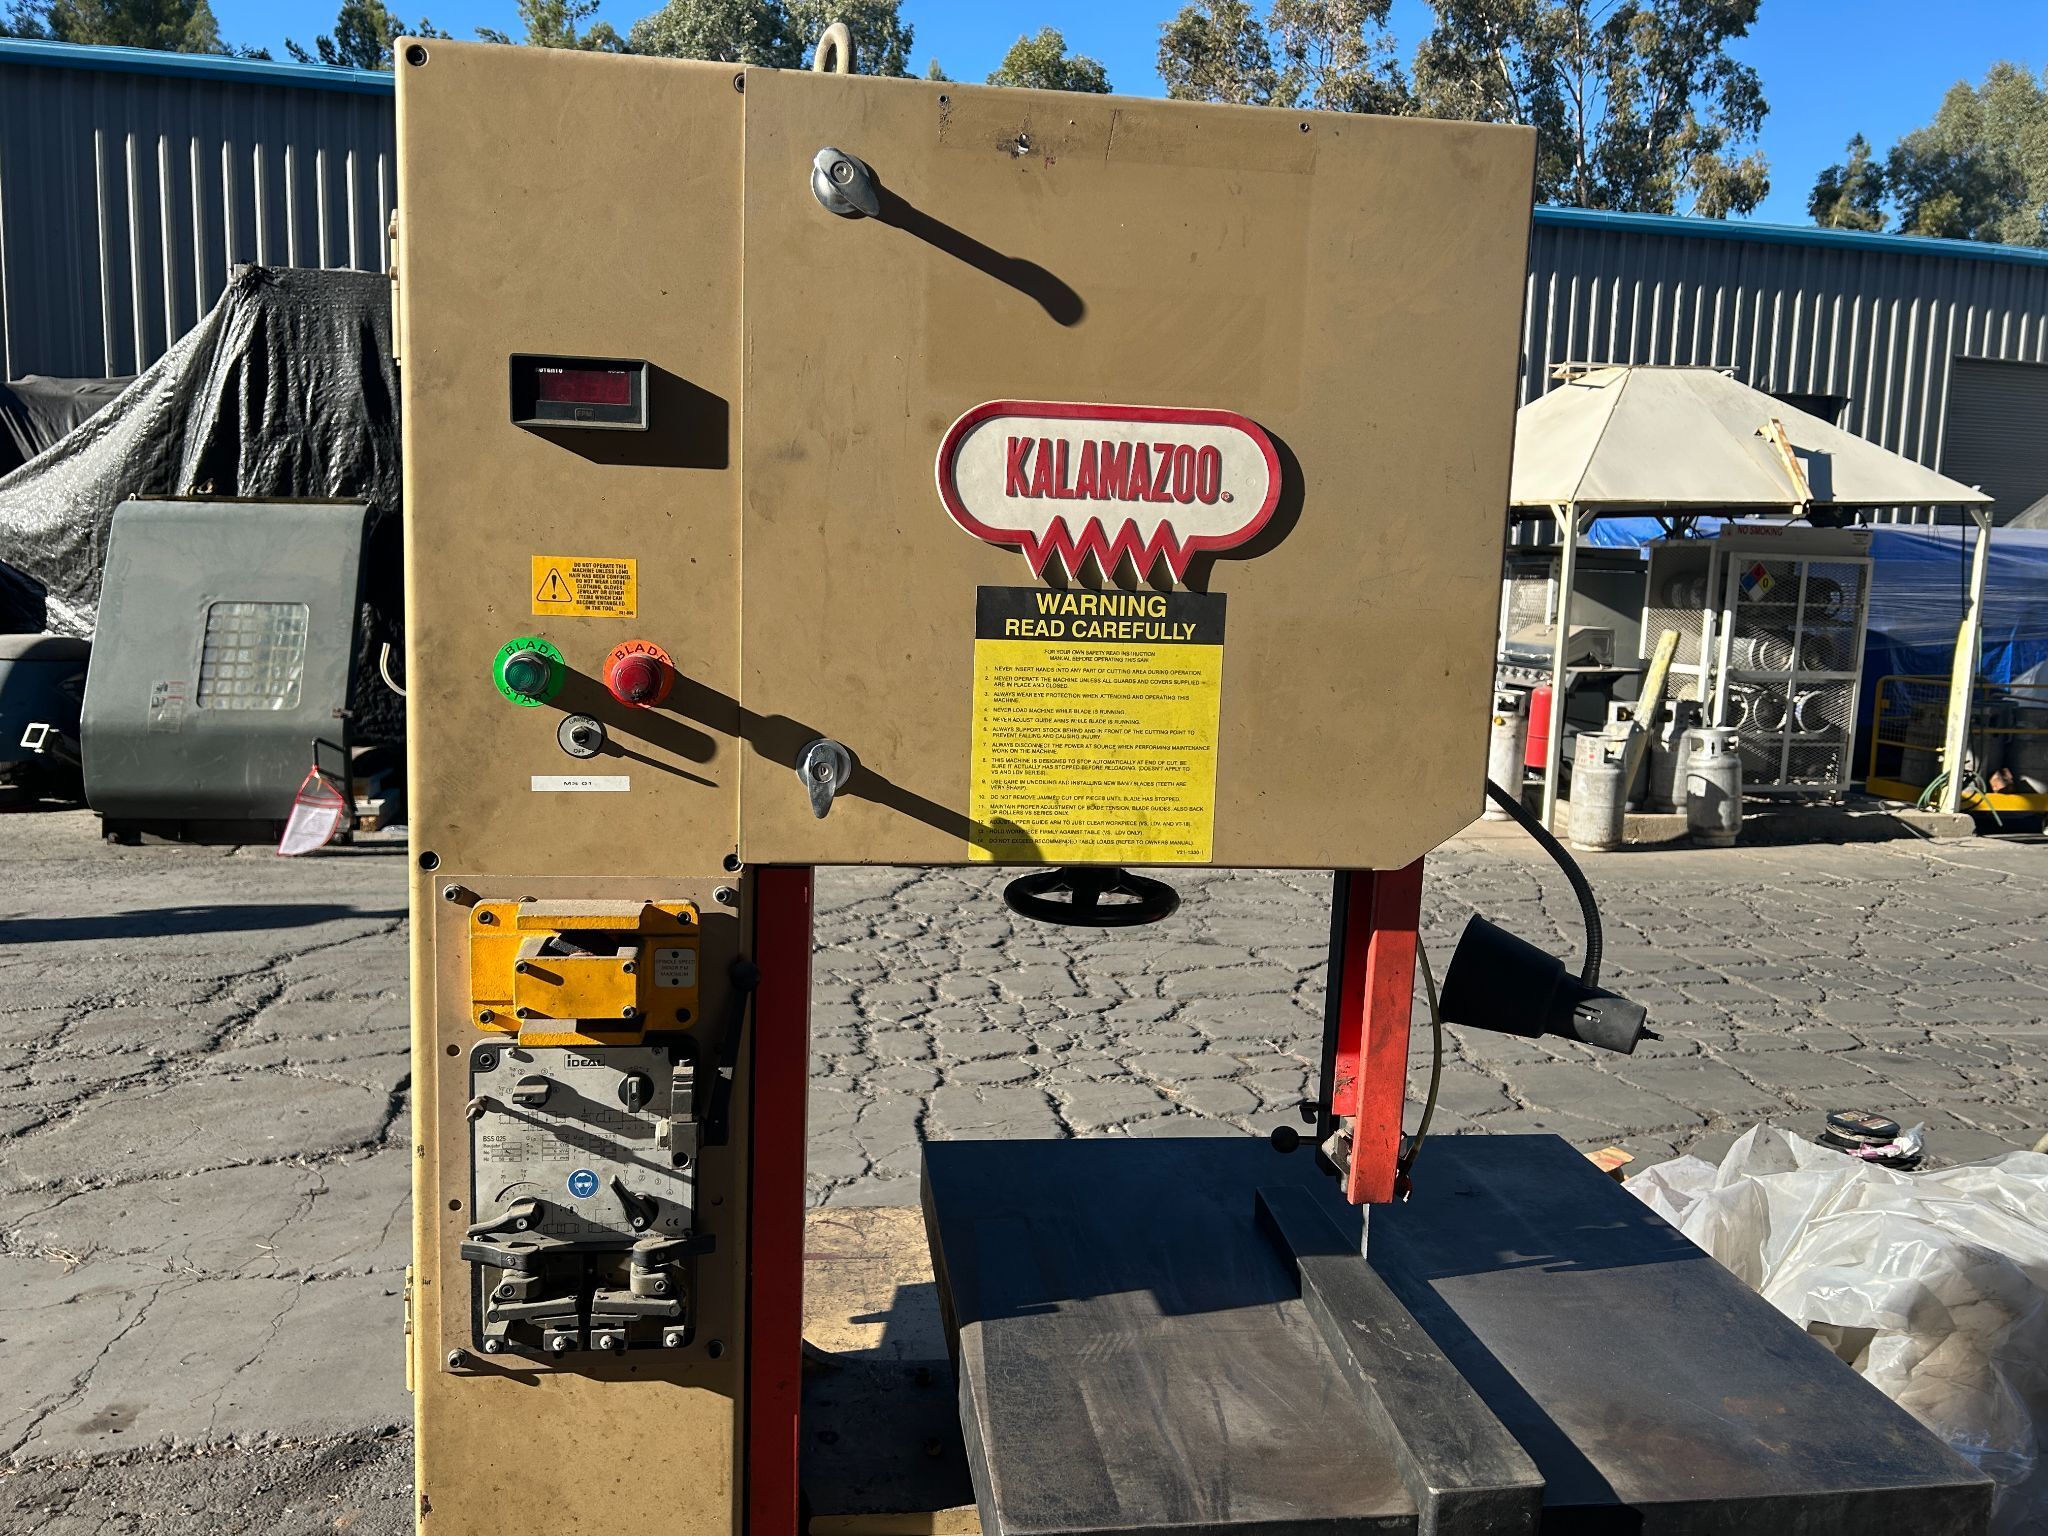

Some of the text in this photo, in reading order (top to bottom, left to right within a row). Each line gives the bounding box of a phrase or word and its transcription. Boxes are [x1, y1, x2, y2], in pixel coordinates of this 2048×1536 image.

[1005, 436, 1222, 505] KALAMAZOO
[1750, 528, 1783, 536] SMOKING
[1762, 578, 1768, 587] 0
[1035, 593, 1168, 618] WARNING
[1005, 619, 1197, 641] READ CAREFULLY
[504, 640, 558, 662] BLADE
[615, 643, 668, 663] BLADE
